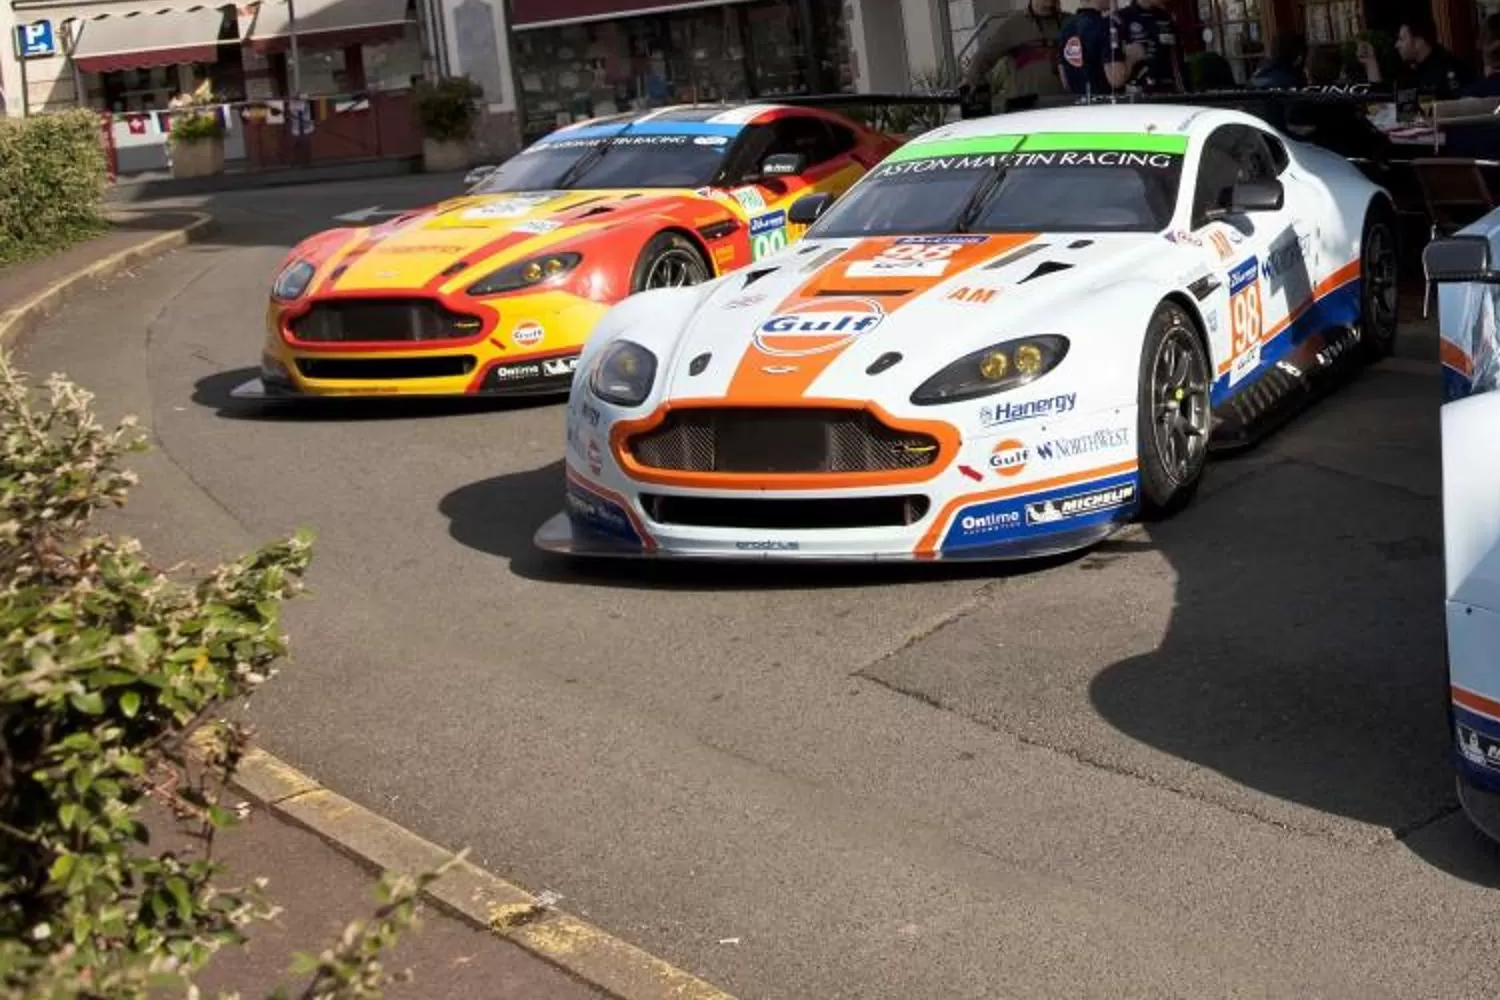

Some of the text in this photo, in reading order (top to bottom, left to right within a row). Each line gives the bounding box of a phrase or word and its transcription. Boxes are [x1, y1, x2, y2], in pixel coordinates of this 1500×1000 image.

[26, 23, 45, 44] P
[876, 158, 953, 179] ASTON
[1060, 151, 1171, 168] RACING
[946, 286, 999, 303] AM
[762, 314, 879, 334] Gulf
[1234, 284, 1259, 353] 98
[995, 392, 1077, 421] Hanergy
[989, 449, 1029, 467] Gulf
[1062, 485, 1133, 512] MICHELIN
[962, 511, 1019, 529] Ontime
